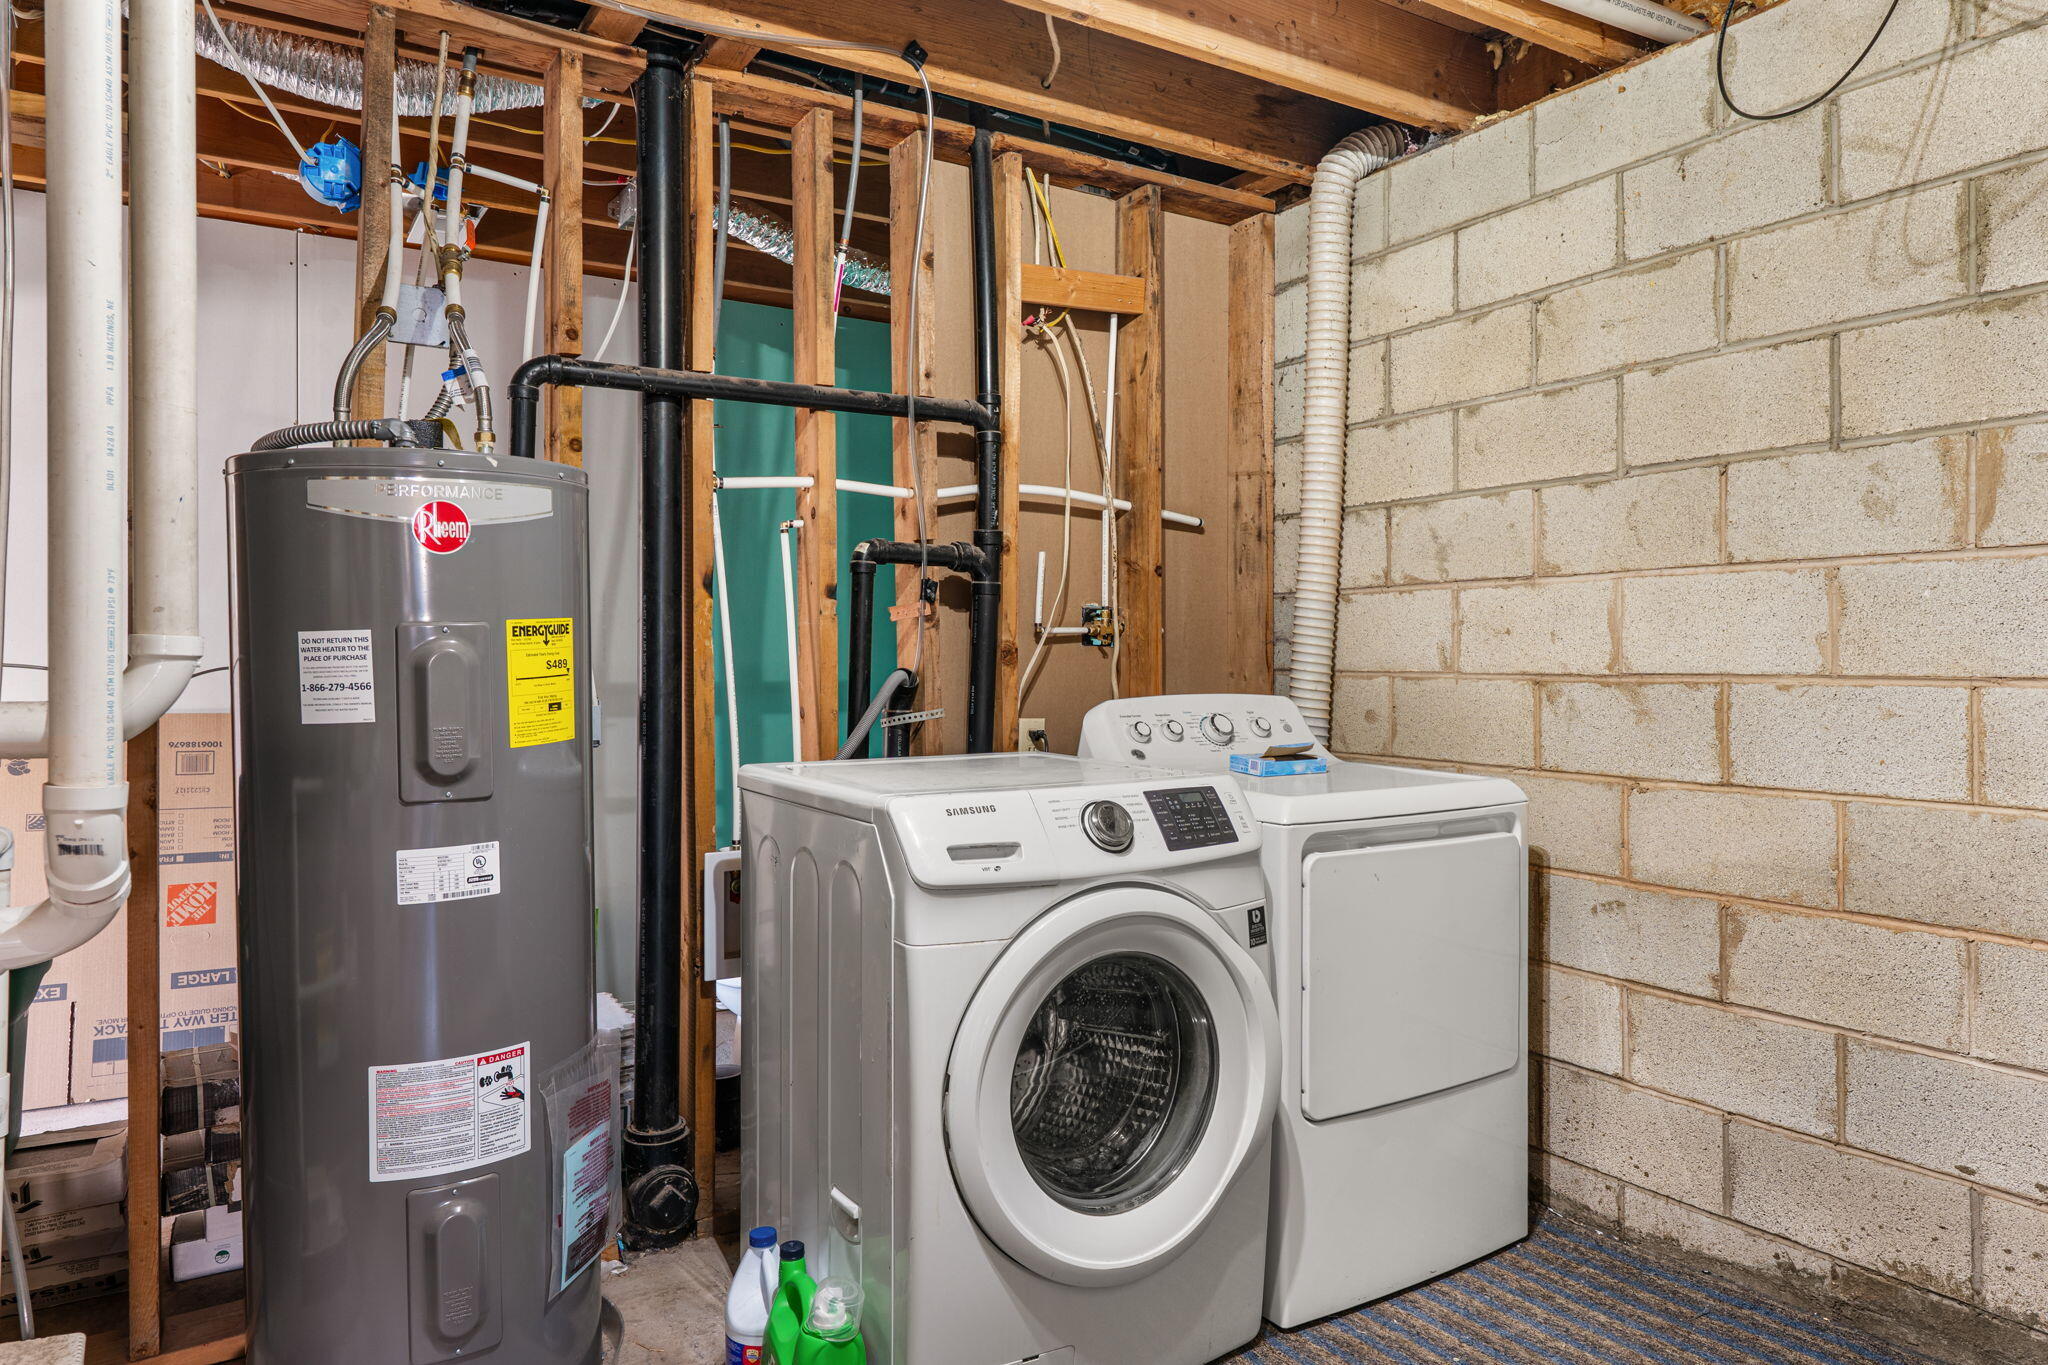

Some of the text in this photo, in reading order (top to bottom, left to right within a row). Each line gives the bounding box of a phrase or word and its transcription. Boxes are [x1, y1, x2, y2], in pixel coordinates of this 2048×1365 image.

[374, 483, 503, 500] PERFORMANCE
[418, 503, 467, 545] Rheem
[512, 624, 570, 638] ENERGYGUIDE
[302, 682, 371, 692] 1-866-279-4566
[945, 804, 996, 816] SAMSUNG
[167, 883, 197, 912] DEPOT
[166, 883, 216, 927] HOME
[191, 904, 211, 921] THE
[178, 971, 230, 985] LARGE
[34, 987, 60, 999] EX
[173, 1015, 204, 1028] WAY
[94, 1024, 128, 1036] ACK
[489, 1050, 522, 1062] DANGER
